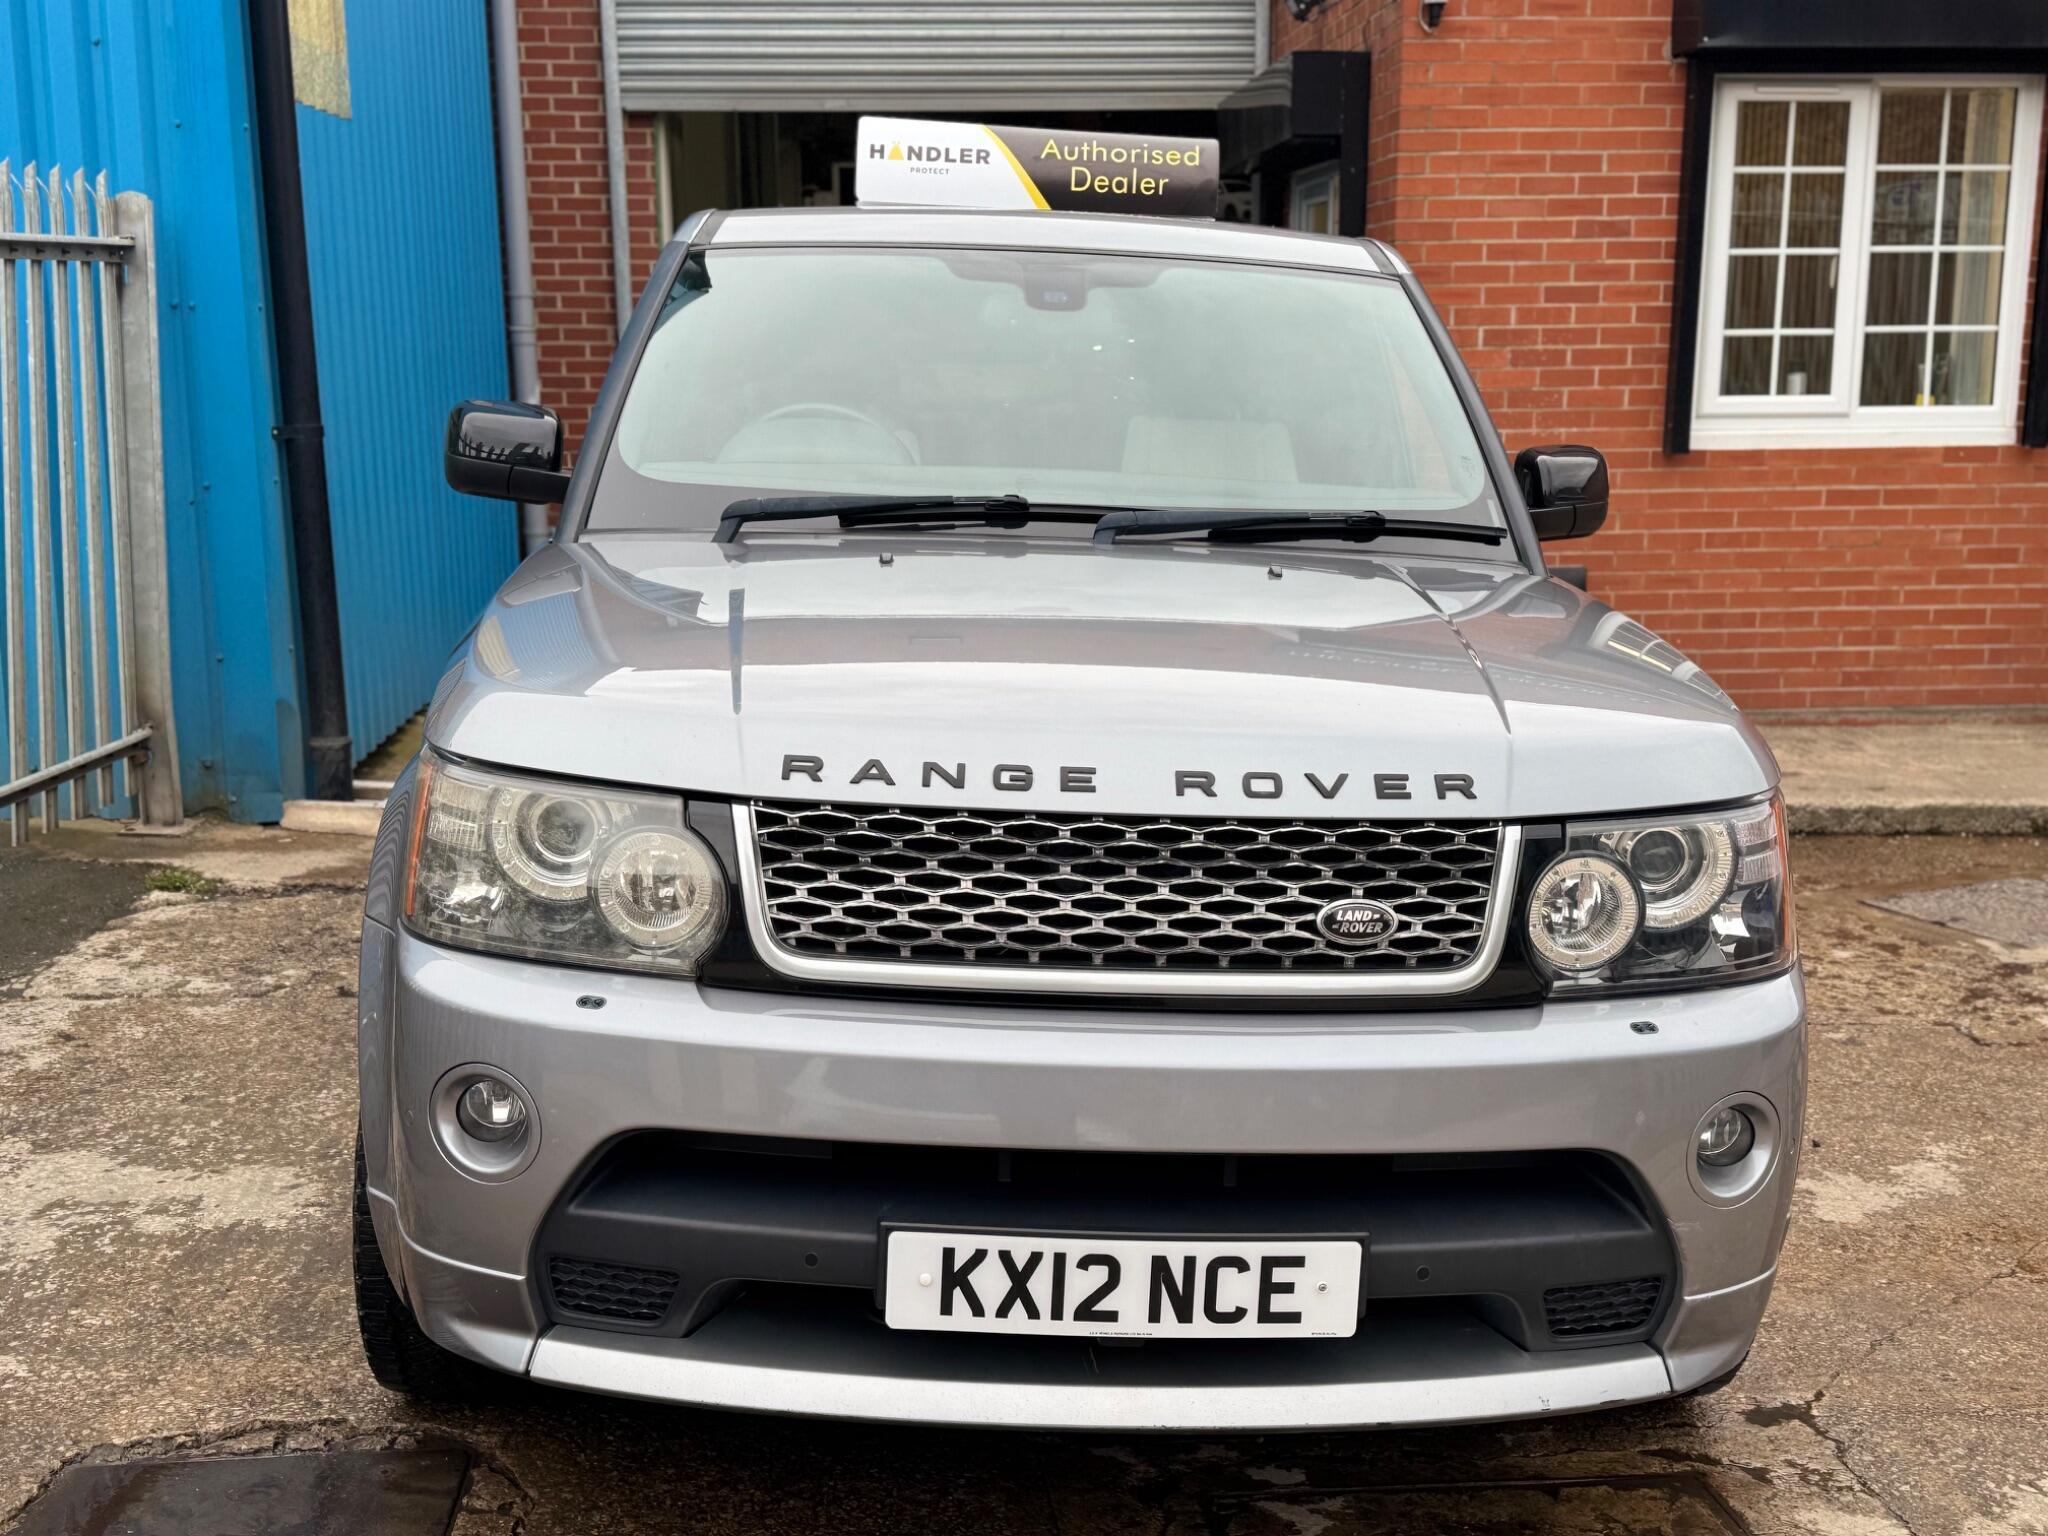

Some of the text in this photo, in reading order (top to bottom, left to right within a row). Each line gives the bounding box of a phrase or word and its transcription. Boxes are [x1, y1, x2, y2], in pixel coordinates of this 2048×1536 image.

[1040, 138, 1201, 166] Authorised
[909, 166, 950, 175] PROTECT
[1070, 166, 1169, 196] Dealer
[781, 754, 1478, 800] RANGE ROVER
[1340, 922, 1383, 933] ROVER
[939, 1246, 1306, 1325] KX12 NCE
